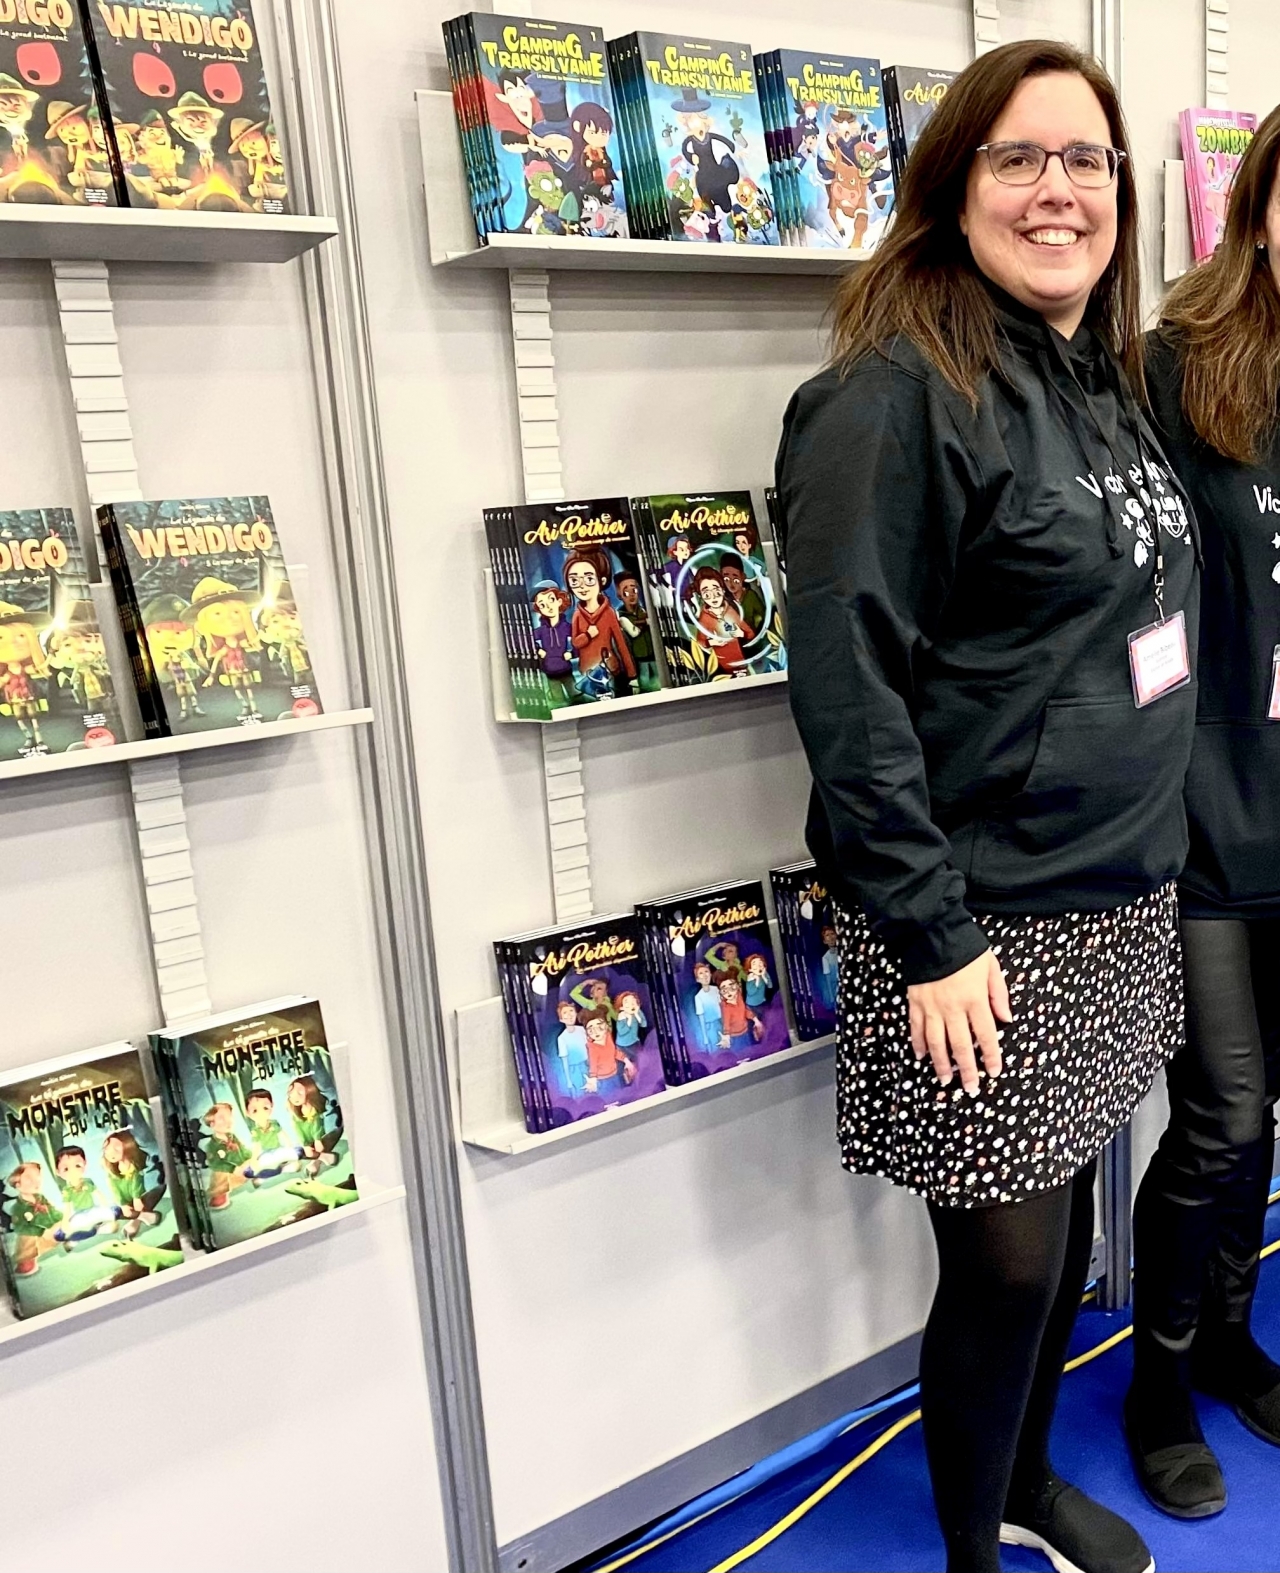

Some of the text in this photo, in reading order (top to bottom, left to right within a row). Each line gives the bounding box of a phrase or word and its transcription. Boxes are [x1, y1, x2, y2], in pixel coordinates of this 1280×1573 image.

[99, 1, 253, 51] WENDIGO
[591, 32, 597, 41] 1
[503, 26, 583, 60] CAMPING
[740, 51, 747, 61] 2
[481, 41, 606, 78] TRANSYLVANIE
[665, 46, 735, 77] CAMPING
[869, 67, 876, 77] 3
[646, 61, 756, 94] TRANSYLVANIE
[787, 77, 882, 108] TRANSYLVANIE
[802, 64, 864, 93] CAMPING
[1075, 466, 1128, 499] Vctor
[524, 519, 560, 546] Ari
[560, 515, 627, 542] Pothier
[660, 506, 750, 533] Ari Pothier
[125, 523, 273, 560] WENDIGO
[674, 915, 701, 938] Ari
[702, 904, 760, 932] Pothier
[536, 951, 567, 976] Ari
[567, 939, 635, 969] Pothier
[202, 1028, 306, 1080] MONSTRE
[258, 1063, 275, 1080] DU
[6, 1080, 121, 1140] MONSTRE
[69, 1117, 88, 1137] DU
